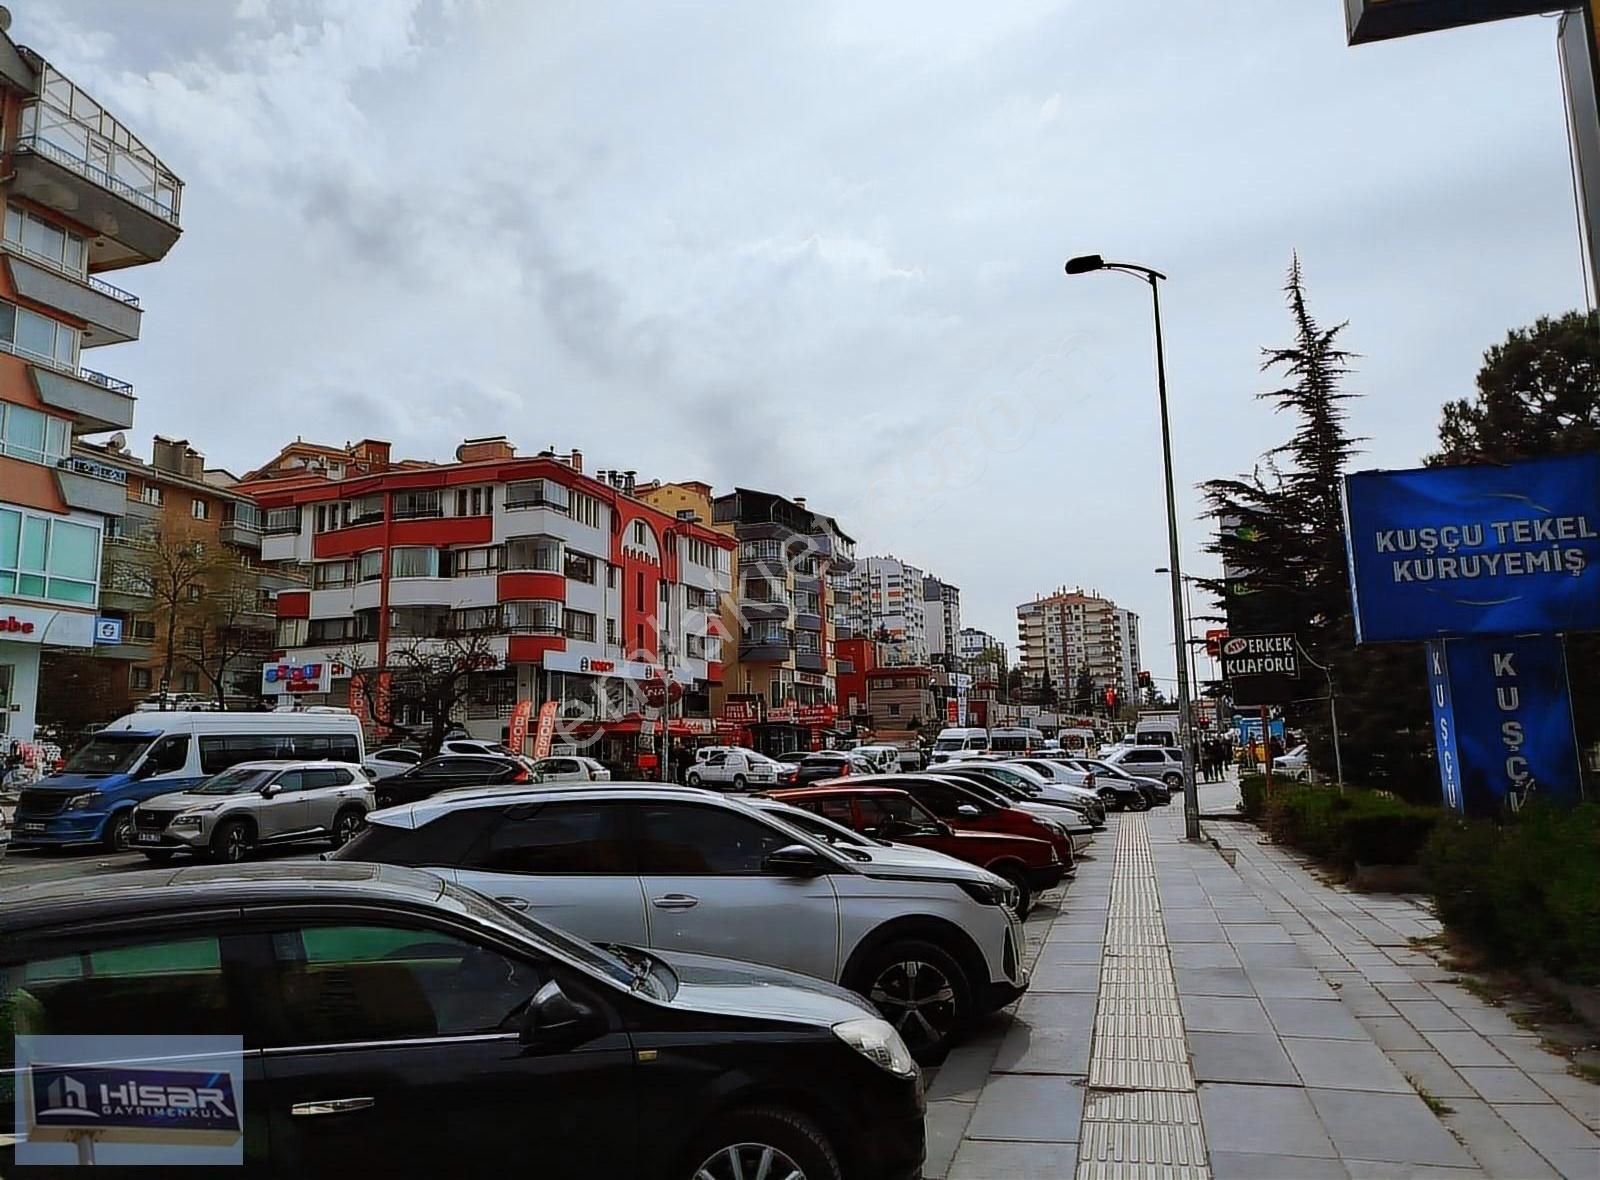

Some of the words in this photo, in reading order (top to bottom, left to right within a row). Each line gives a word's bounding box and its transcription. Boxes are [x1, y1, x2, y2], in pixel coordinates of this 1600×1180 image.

[1376, 523, 1483, 554] KUŞÇU
[1491, 516, 1597, 544] TEKEL
[1393, 543, 1585, 583] KURUYEMİŞ
[1249, 637, 1293, 653] ERKEK
[1226, 653, 1294, 673] KUAFÖRÜ
